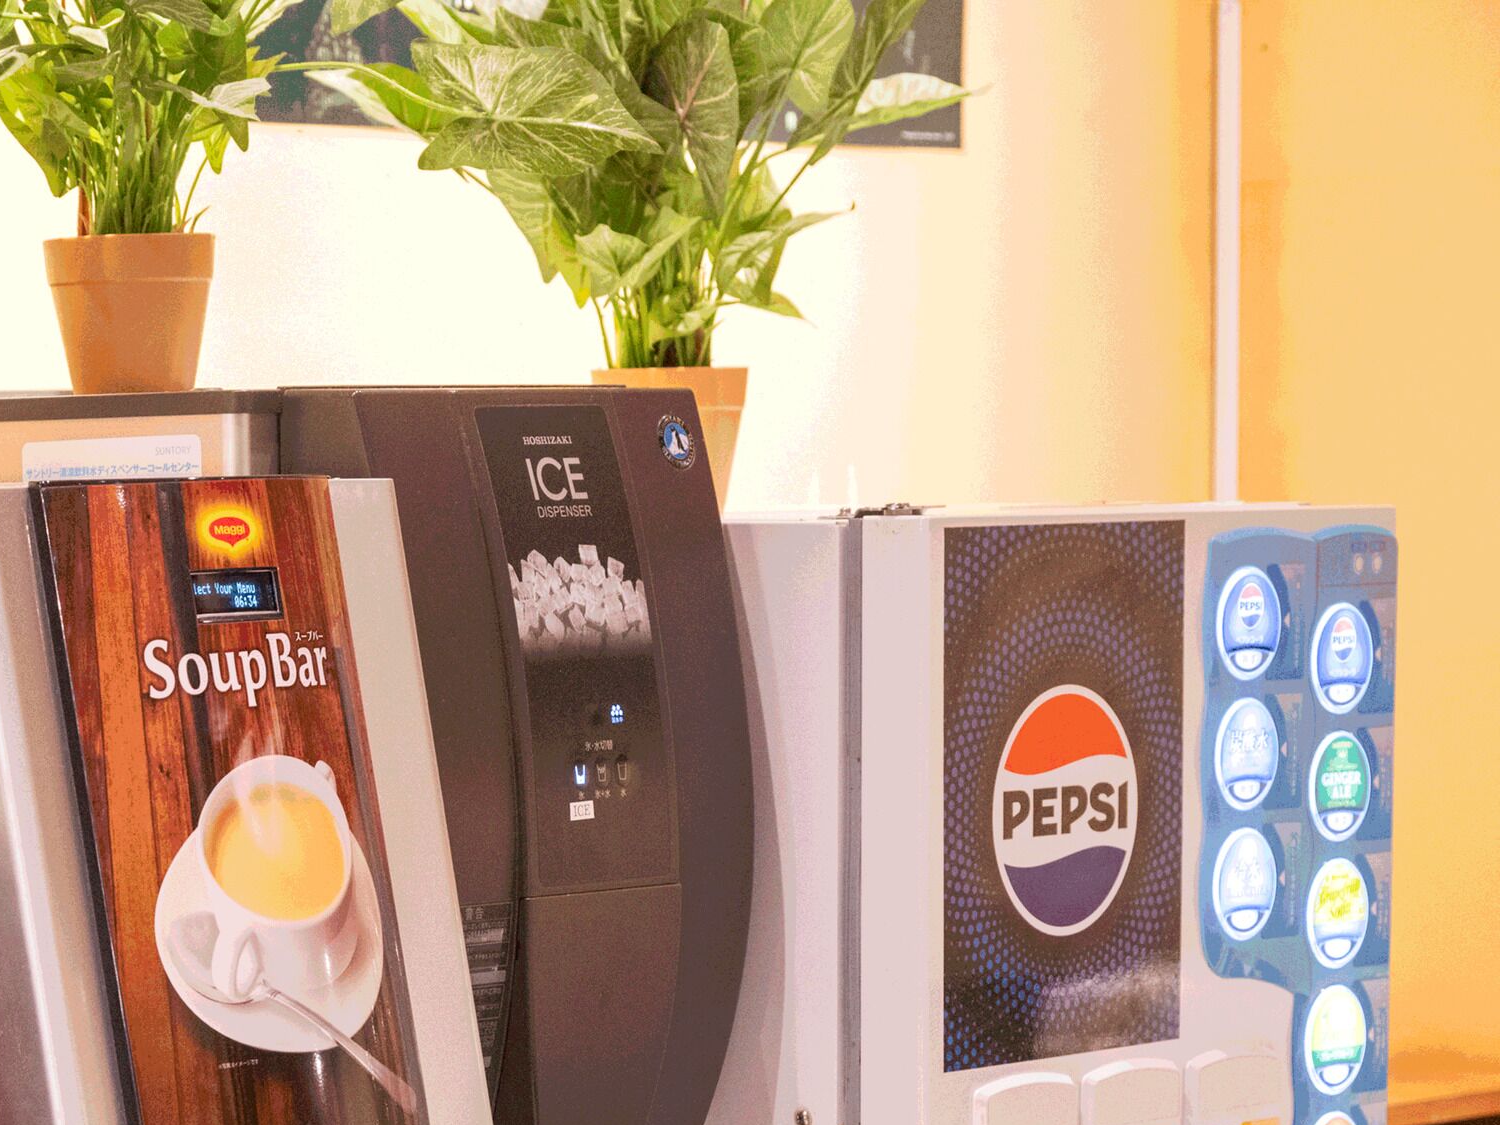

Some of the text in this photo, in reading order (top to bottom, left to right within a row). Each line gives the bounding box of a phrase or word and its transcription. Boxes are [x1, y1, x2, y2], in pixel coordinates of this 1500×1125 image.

[522, 435, 572, 446] HOSHIZAKI
[155, 446, 192, 456] SUNTORY
[525, 457, 589, 501] ICE
[537, 504, 593, 518] DISPENSER
[213, 524, 245, 535] Maggi
[193, 582, 256, 595] lect Your Menu
[234, 595, 258, 608] 06:34
[295, 631, 324, 642] スープバー
[1321, 771, 1362, 786] GINGER
[573, 804, 591, 817] ICE
[1003, 780, 1128, 840] PEPSI
